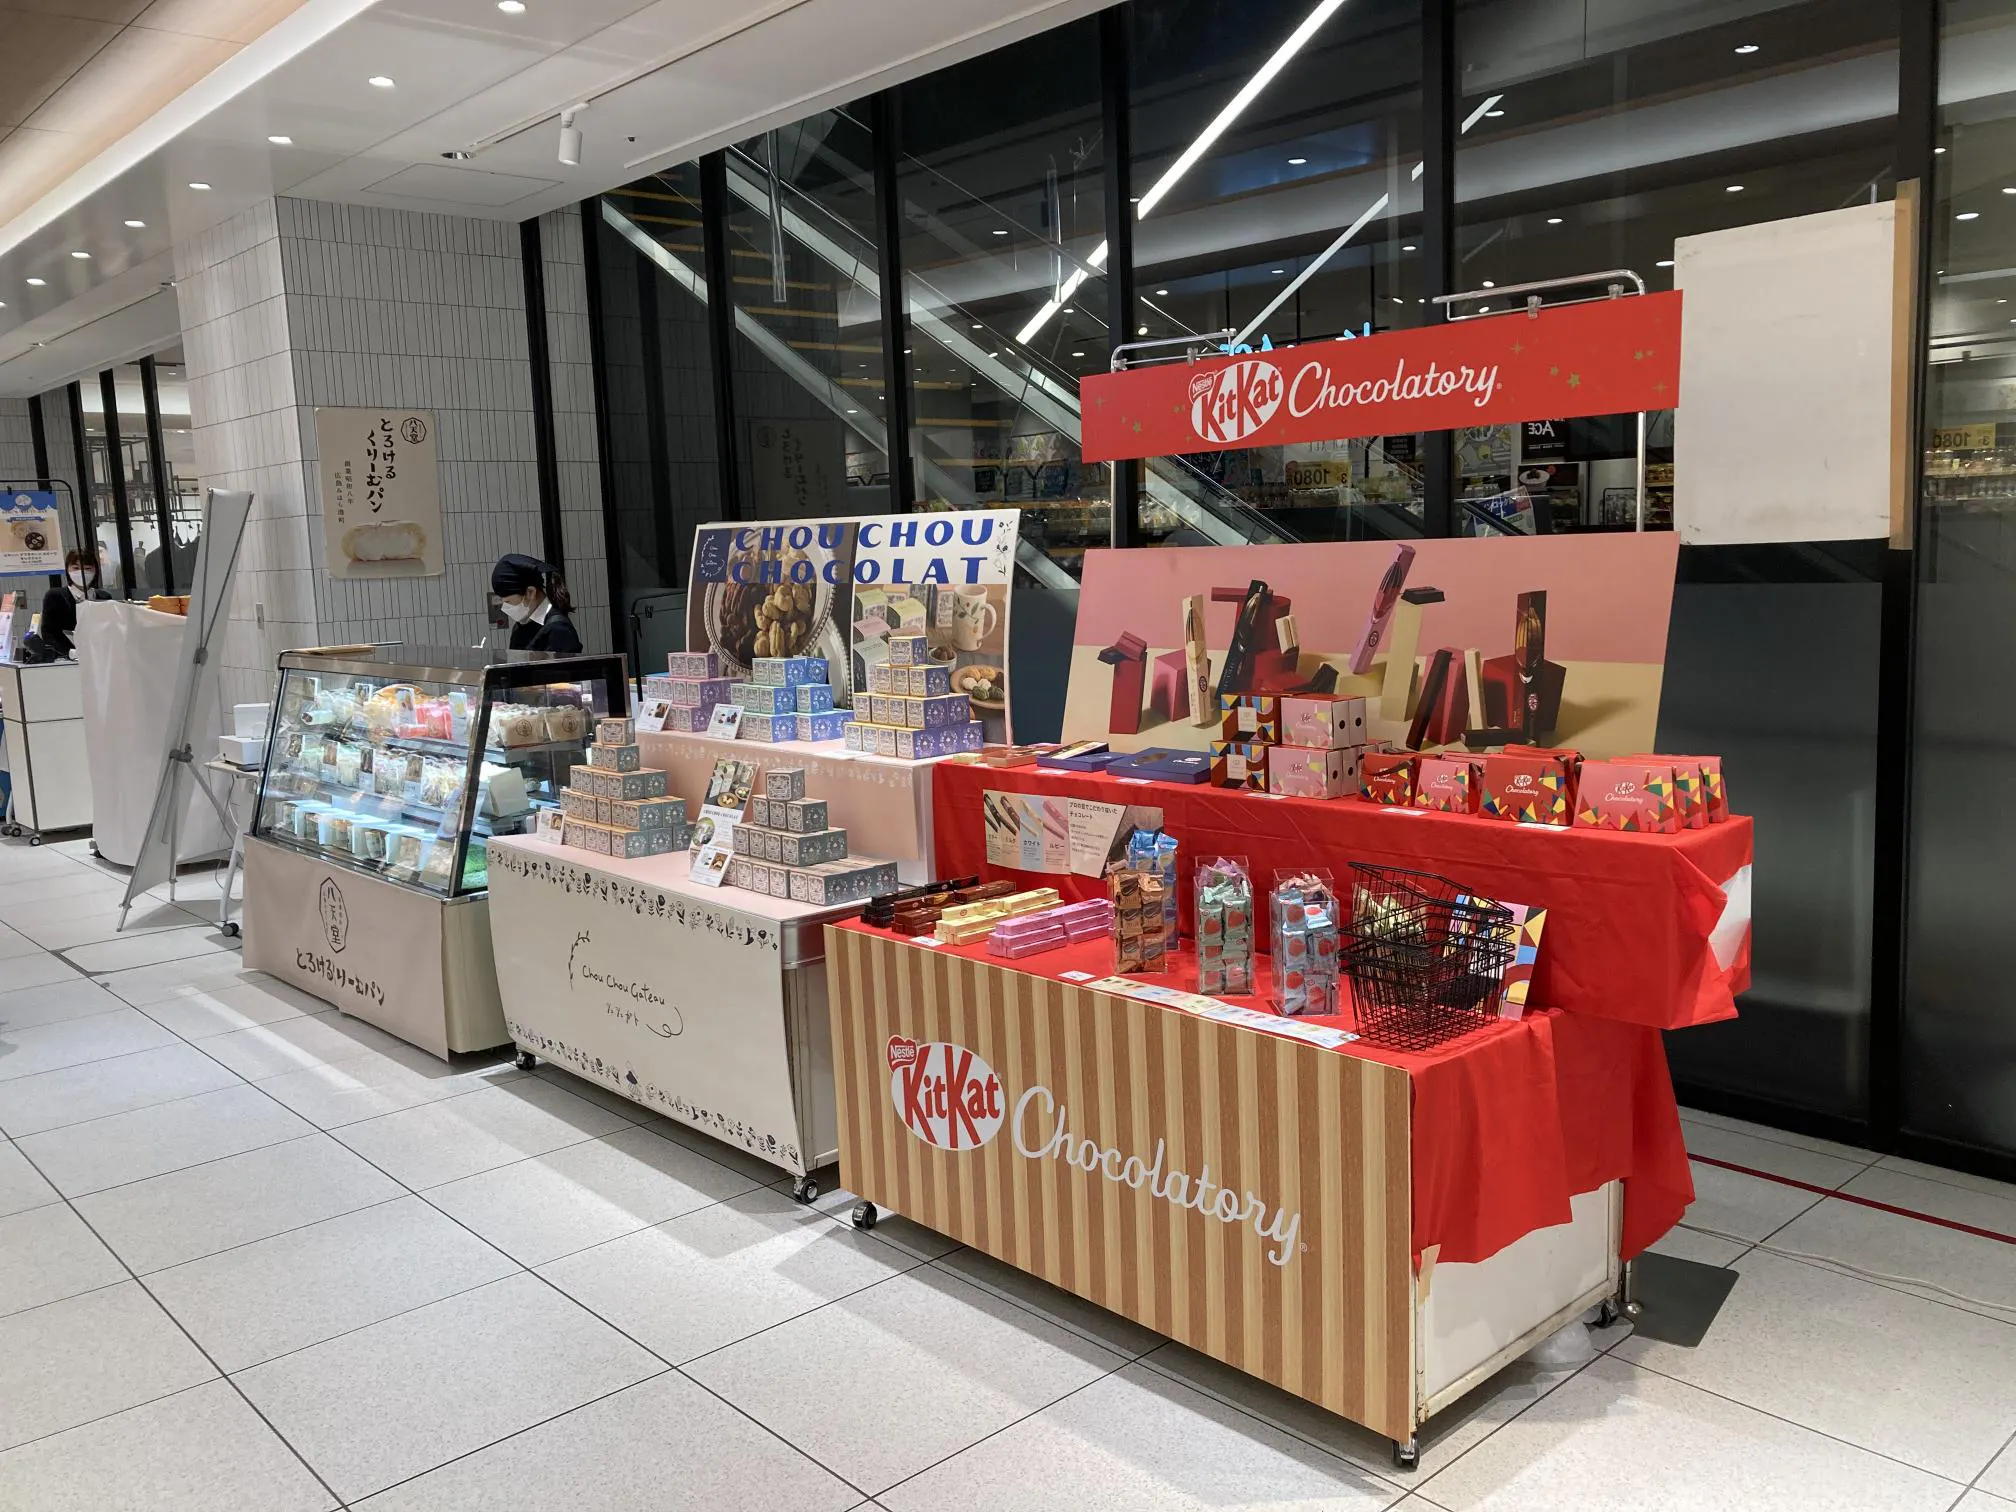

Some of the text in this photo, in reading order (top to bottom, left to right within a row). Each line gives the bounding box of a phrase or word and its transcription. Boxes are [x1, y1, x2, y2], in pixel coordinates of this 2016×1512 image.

[1289, 358, 1498, 418] Chocolatory
[366, 429, 384, 513] くりーむパン
[380, 418, 396, 479] とろける
[735, 518, 994, 551] CHOU CHOU
[732, 557, 988, 585] CHOCOLAT
[582, 964, 604, 983] Chou
[606, 974, 629, 993] Chou
[902, 1044, 1001, 1150] KitKat
[1012, 1085, 1301, 1267] Chocolatory
